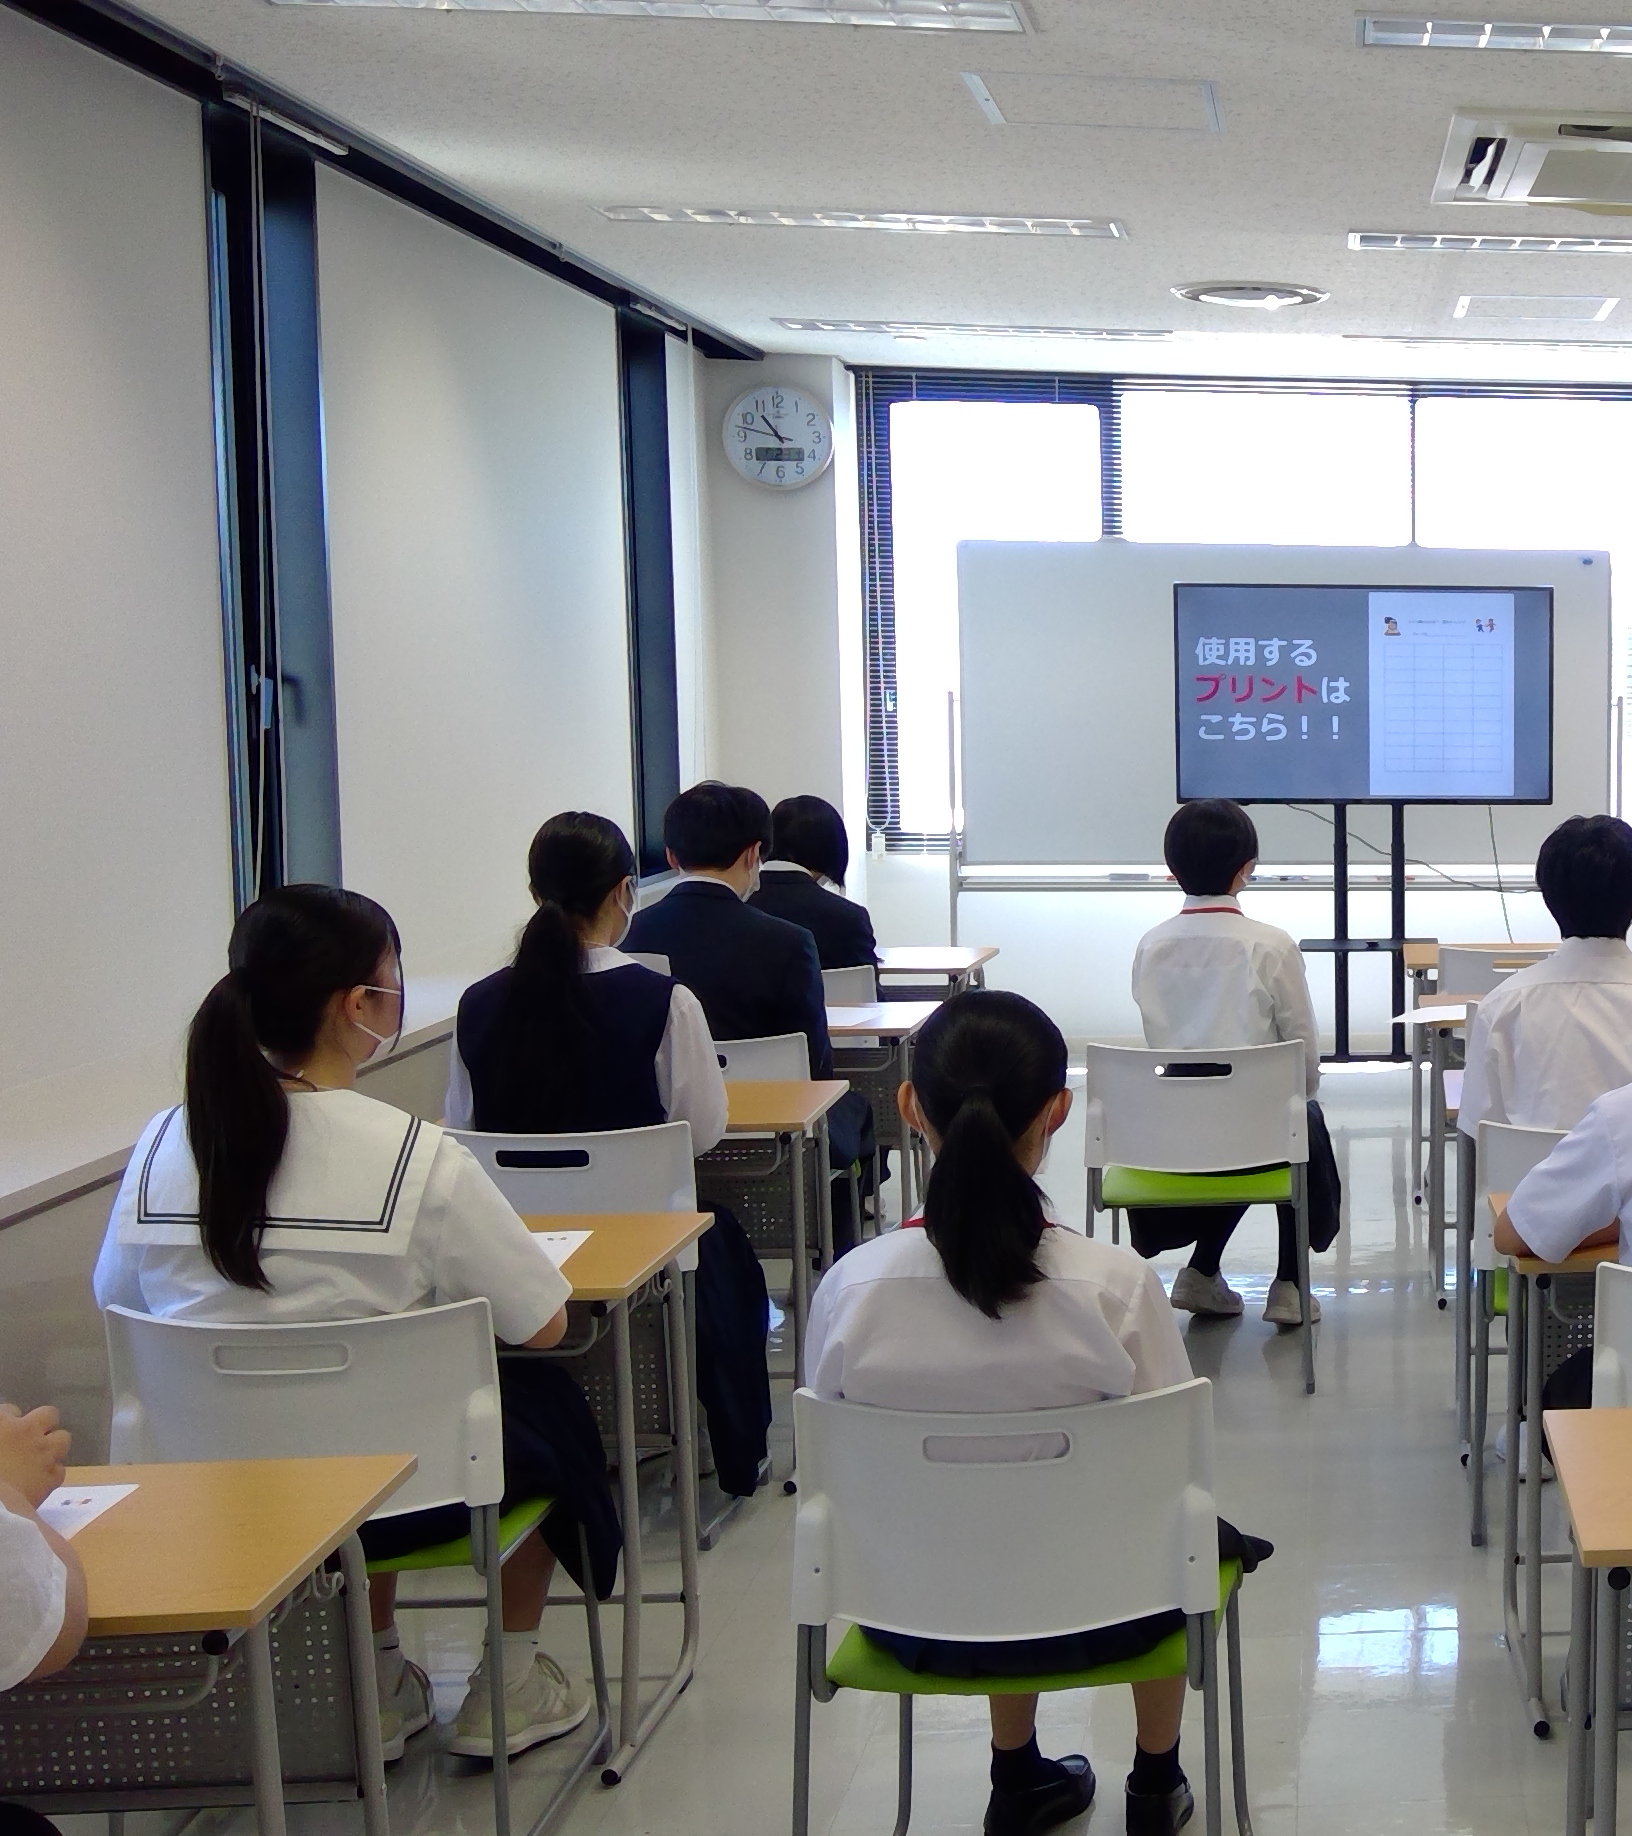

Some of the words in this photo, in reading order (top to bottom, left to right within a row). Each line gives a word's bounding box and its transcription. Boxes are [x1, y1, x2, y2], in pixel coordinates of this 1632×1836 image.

[755, 399, 766, 413] 11
[771, 394, 784, 409] 12
[741, 411, 755, 426] 10
[806, 412, 816, 426] 2
[737, 429, 747, 443] 9
[812, 430, 822, 444] 3
[743, 447, 754, 460] 8
[807, 448, 817, 461] 4
[757, 461, 766, 476] 7
[775, 465, 786, 479] 6
[795, 461, 805, 475] 5
[1195, 637, 1318, 666] 使用する
[1195, 673, 1351, 704] プリントは
[1198, 713, 1341, 741] こちら！！
